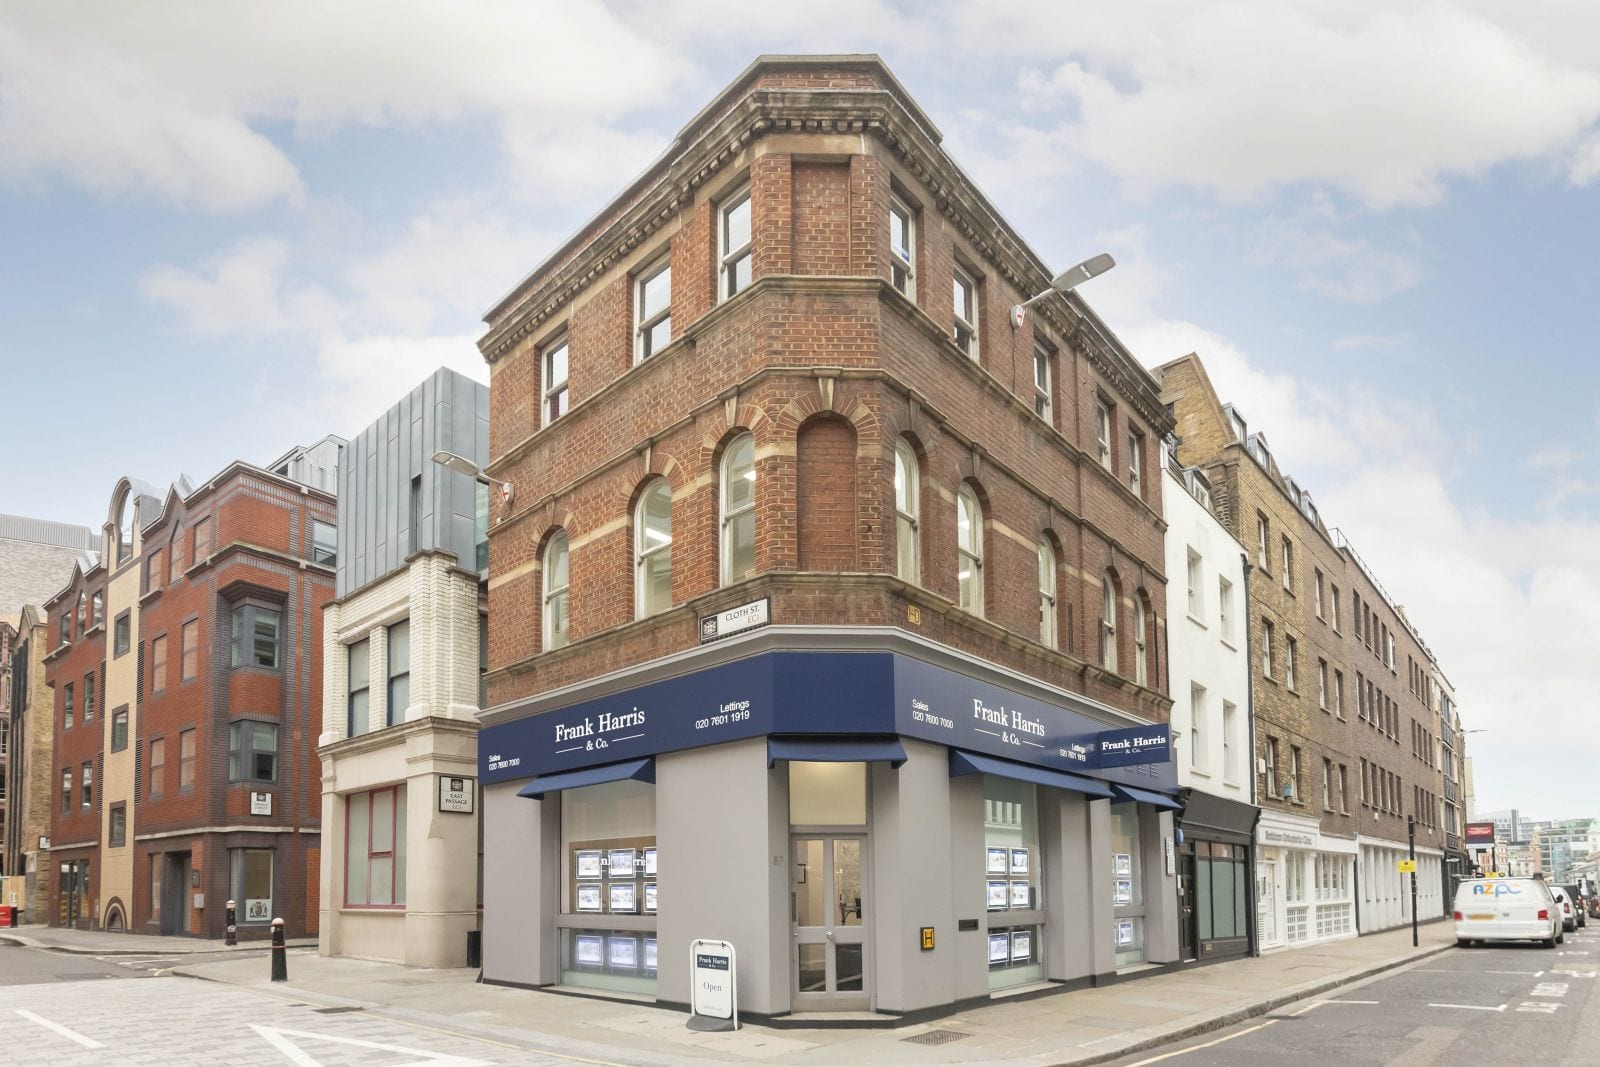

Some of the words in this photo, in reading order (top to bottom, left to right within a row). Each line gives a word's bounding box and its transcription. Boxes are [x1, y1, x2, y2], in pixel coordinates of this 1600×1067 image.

[725, 608, 749, 621] CLOTH
[750, 605, 760, 613] ST.
[720, 700, 750, 713] Lettings
[912, 698, 929, 712] Sales
[555, 717, 594, 742] Frank
[597, 706, 645, 733] Harris
[695, 718, 709, 730] 020
[710, 714, 728, 727] 7601
[731, 710, 750, 722] 1919
[912, 710, 924, 722] 020
[925, 713, 939, 726] 7600
[939, 717, 954, 729] 7000
[973, 698, 1009, 727] Frank
[1011, 710, 1045, 737] Harris
[586, 740, 594, 751] &
[595, 738, 609, 749] Co.
[1002, 731, 1009, 743] &
[1009, 733, 1021, 746] Co.
[1102, 739, 1131, 750] Frank
[1133, 735, 1167, 747] Harris
[703, 980, 722, 993] Open
